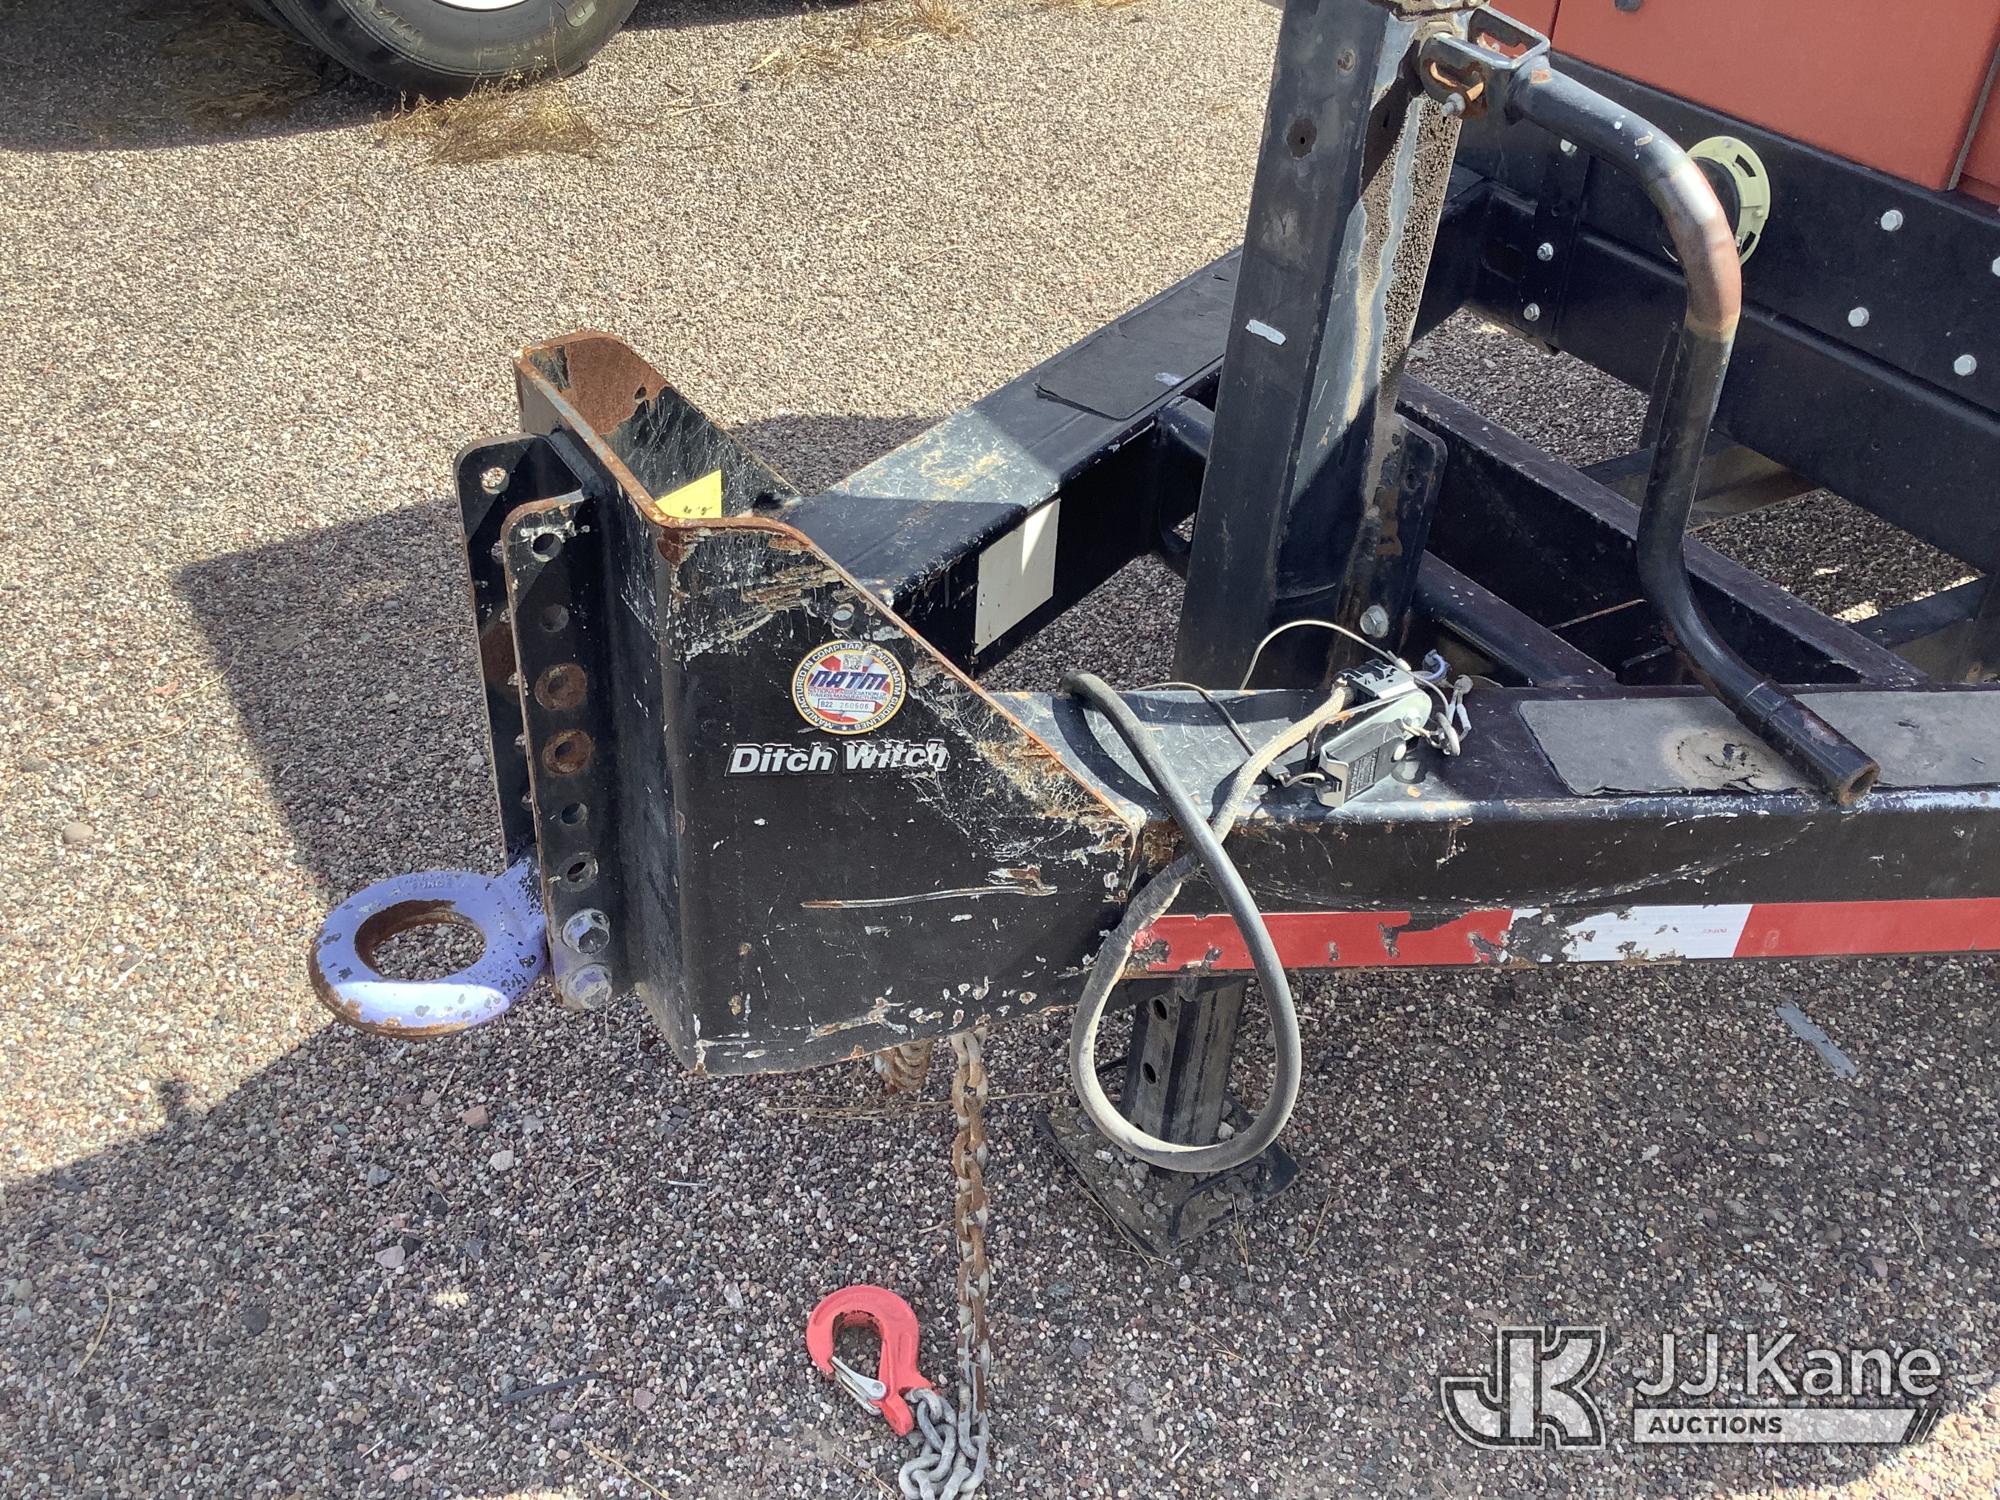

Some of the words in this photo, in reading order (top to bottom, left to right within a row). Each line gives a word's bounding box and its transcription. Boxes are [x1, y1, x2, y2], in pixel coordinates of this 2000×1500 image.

[803, 661, 814, 671] IN
[809, 670, 890, 691] NATM
[796, 669, 834, 729] MANUFACTURED
[854, 697, 899, 730] GUIDELINES
[730, 747, 834, 773] Ditch
[846, 743, 947, 771] Witch
